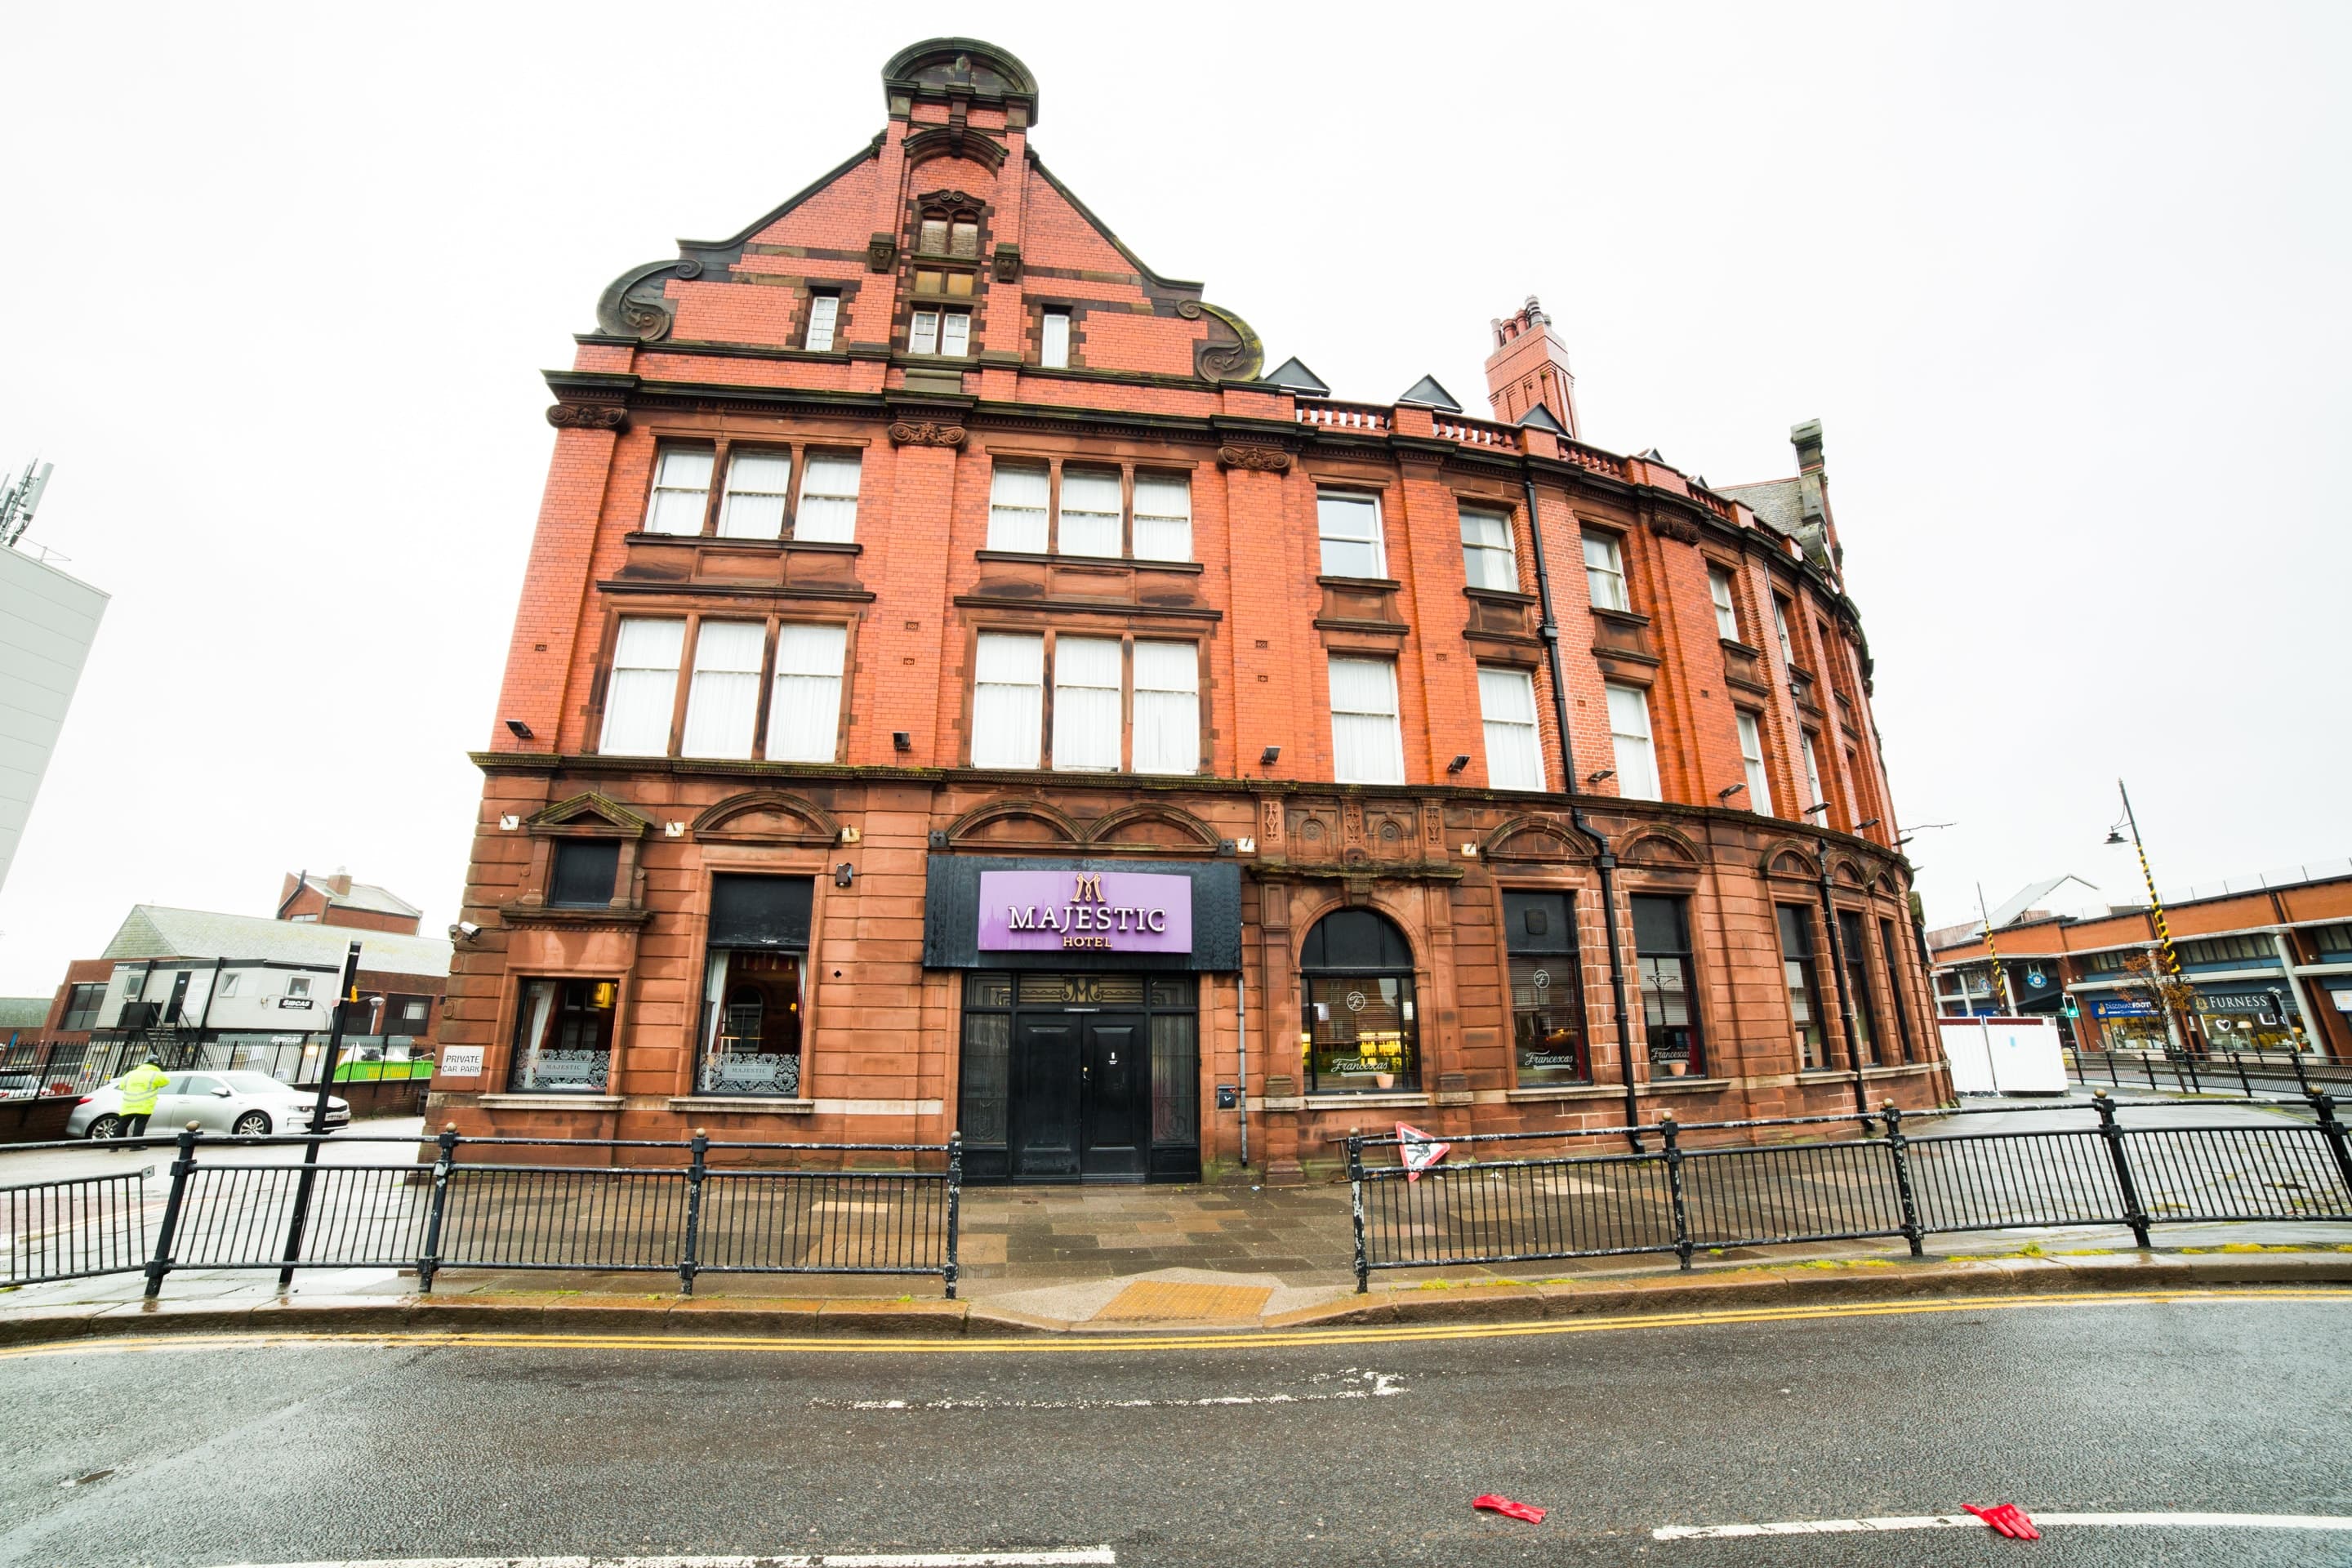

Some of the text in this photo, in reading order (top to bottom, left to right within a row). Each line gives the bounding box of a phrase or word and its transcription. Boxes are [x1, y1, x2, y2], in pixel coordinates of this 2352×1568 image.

[1008, 906, 1166, 933] MAJESTIC
[1062, 936, 1113, 948] HOTEL
[2208, 995, 2269, 1009] FURNESS
[445, 1054, 480, 1063] PRIVATE
[460, 1065, 480, 1073] PARK
